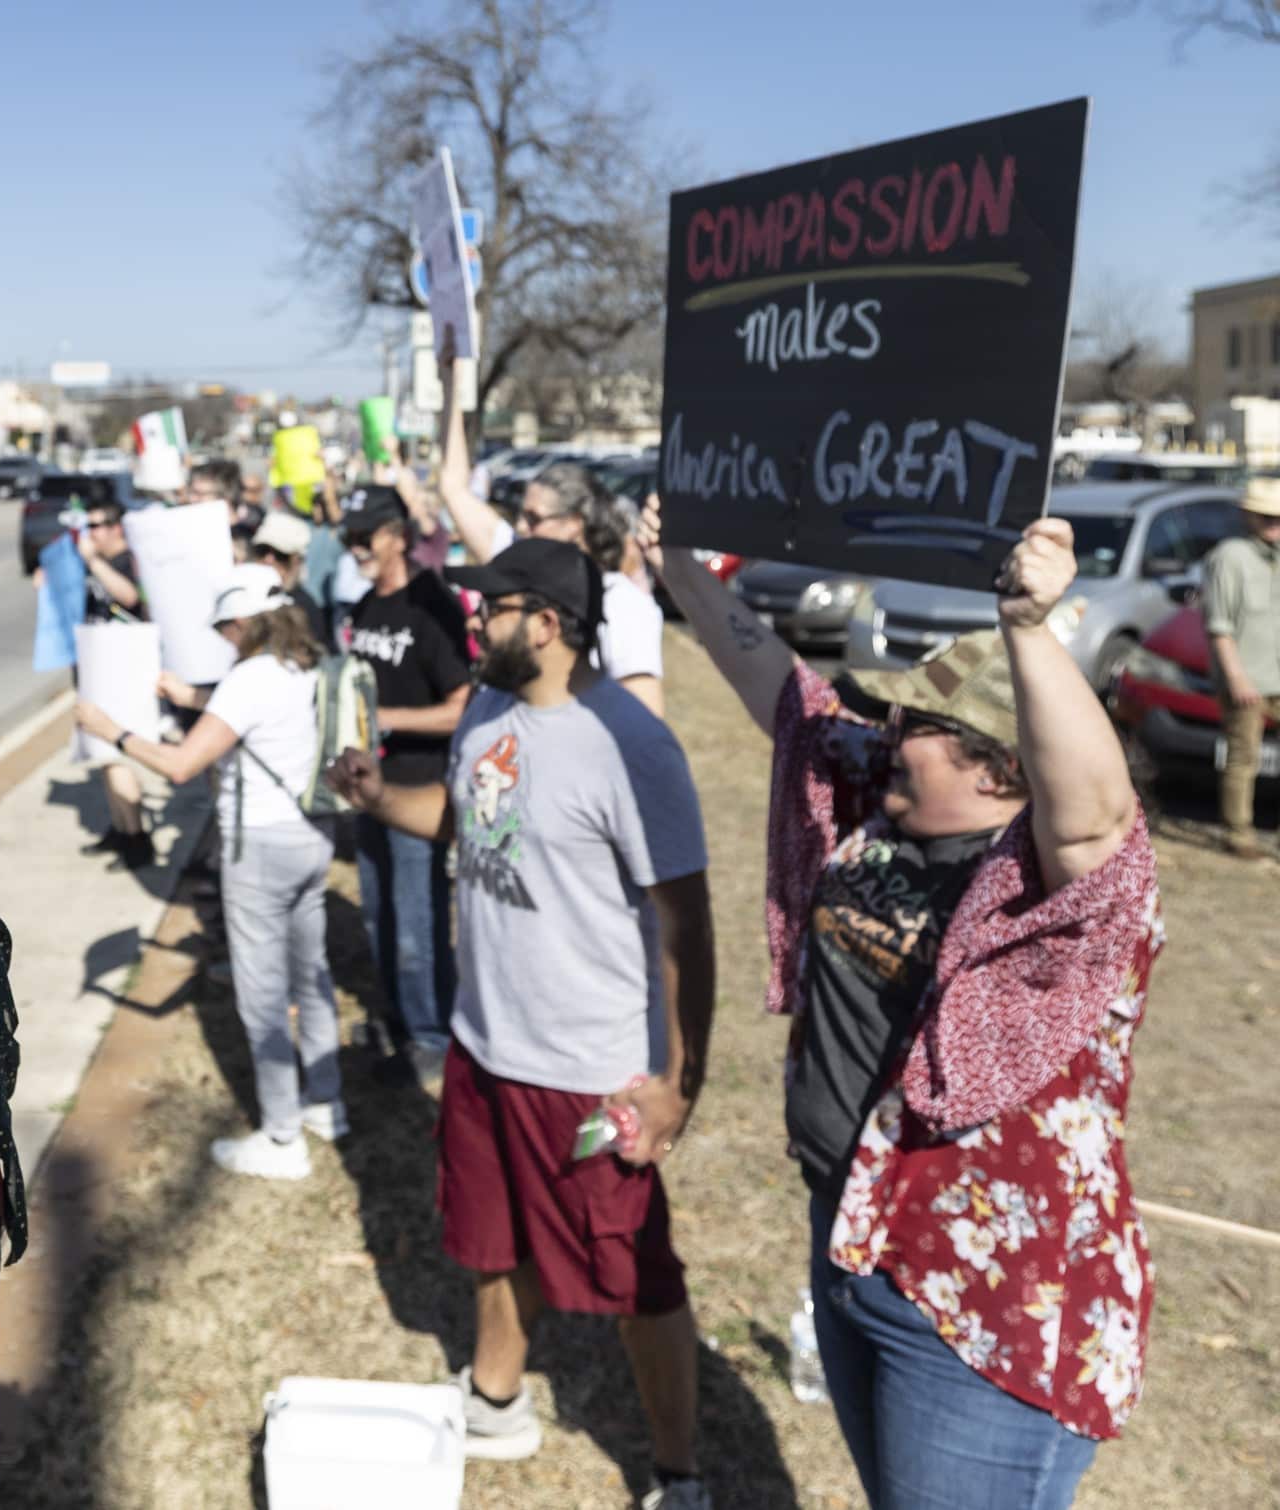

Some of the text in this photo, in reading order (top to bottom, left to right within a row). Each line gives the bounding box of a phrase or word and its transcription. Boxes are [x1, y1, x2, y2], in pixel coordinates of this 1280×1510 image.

[686, 154, 1016, 282] COMPASSION
[736, 281, 882, 372] makes
[813, 410, 1038, 529] GREAT
